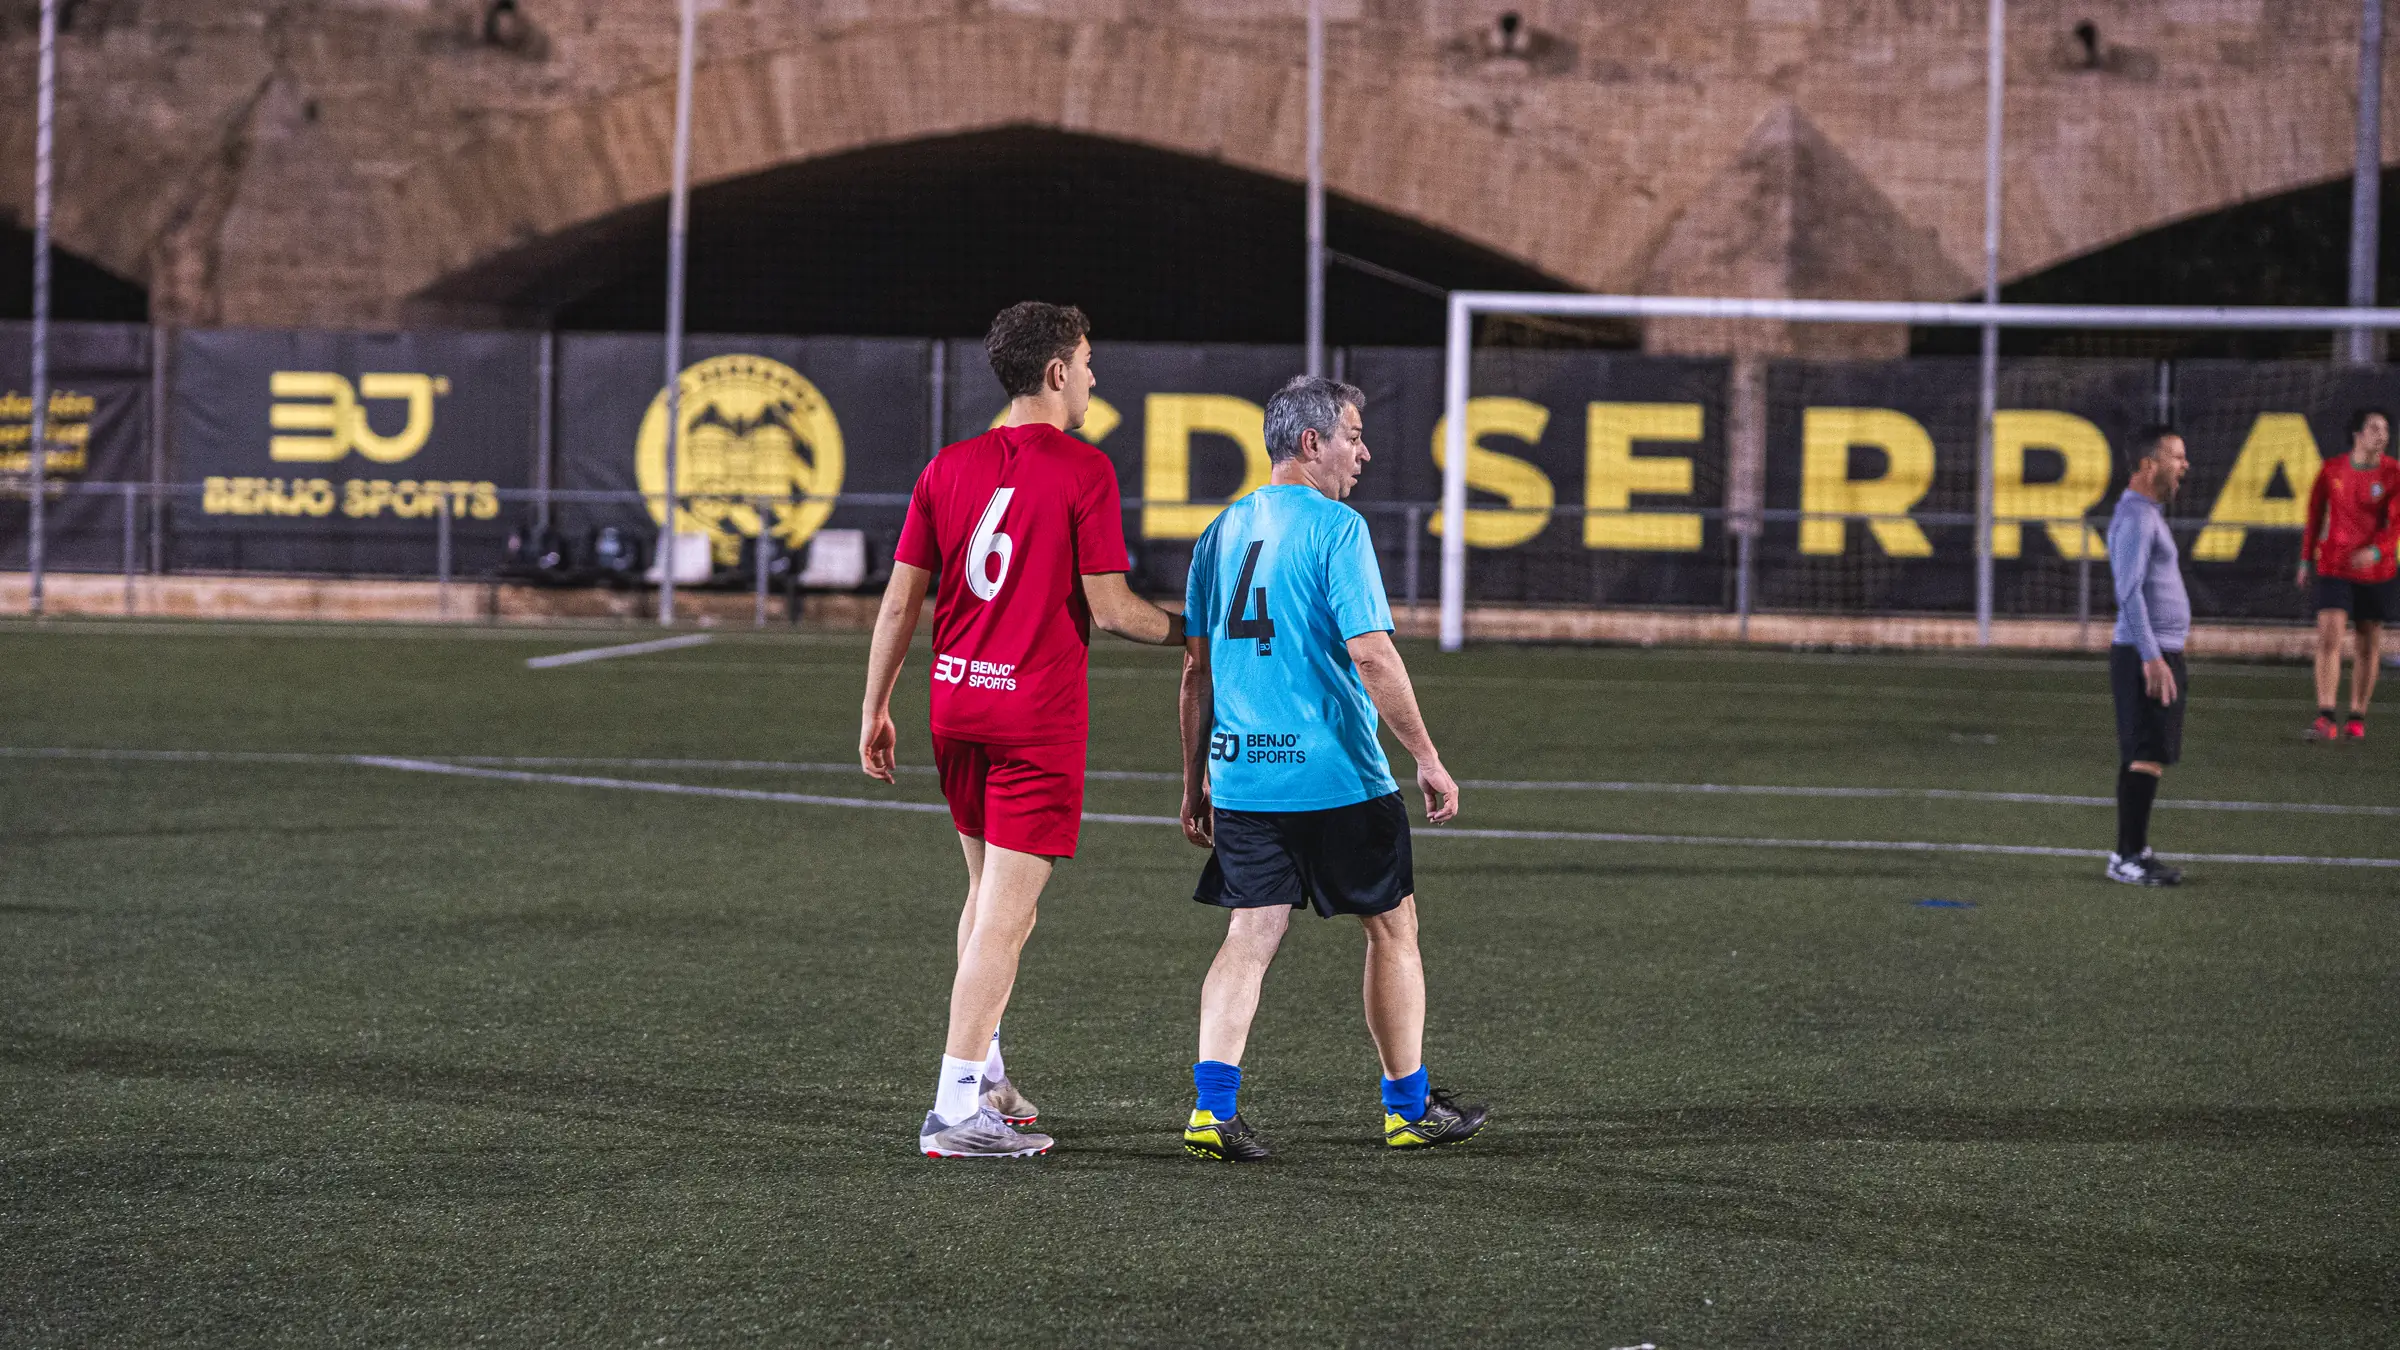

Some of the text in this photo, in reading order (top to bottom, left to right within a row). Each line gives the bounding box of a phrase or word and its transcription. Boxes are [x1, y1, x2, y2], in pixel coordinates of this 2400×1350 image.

[203, 476, 498, 519] BENJO SPORTS
[988, 393, 2400, 565] D SERRA
[966, 487, 1015, 601] 6
[1224, 540, 1276, 656] 4
[968, 674, 1017, 691] SPORTS
[1247, 750, 1306, 764] SPORTS
